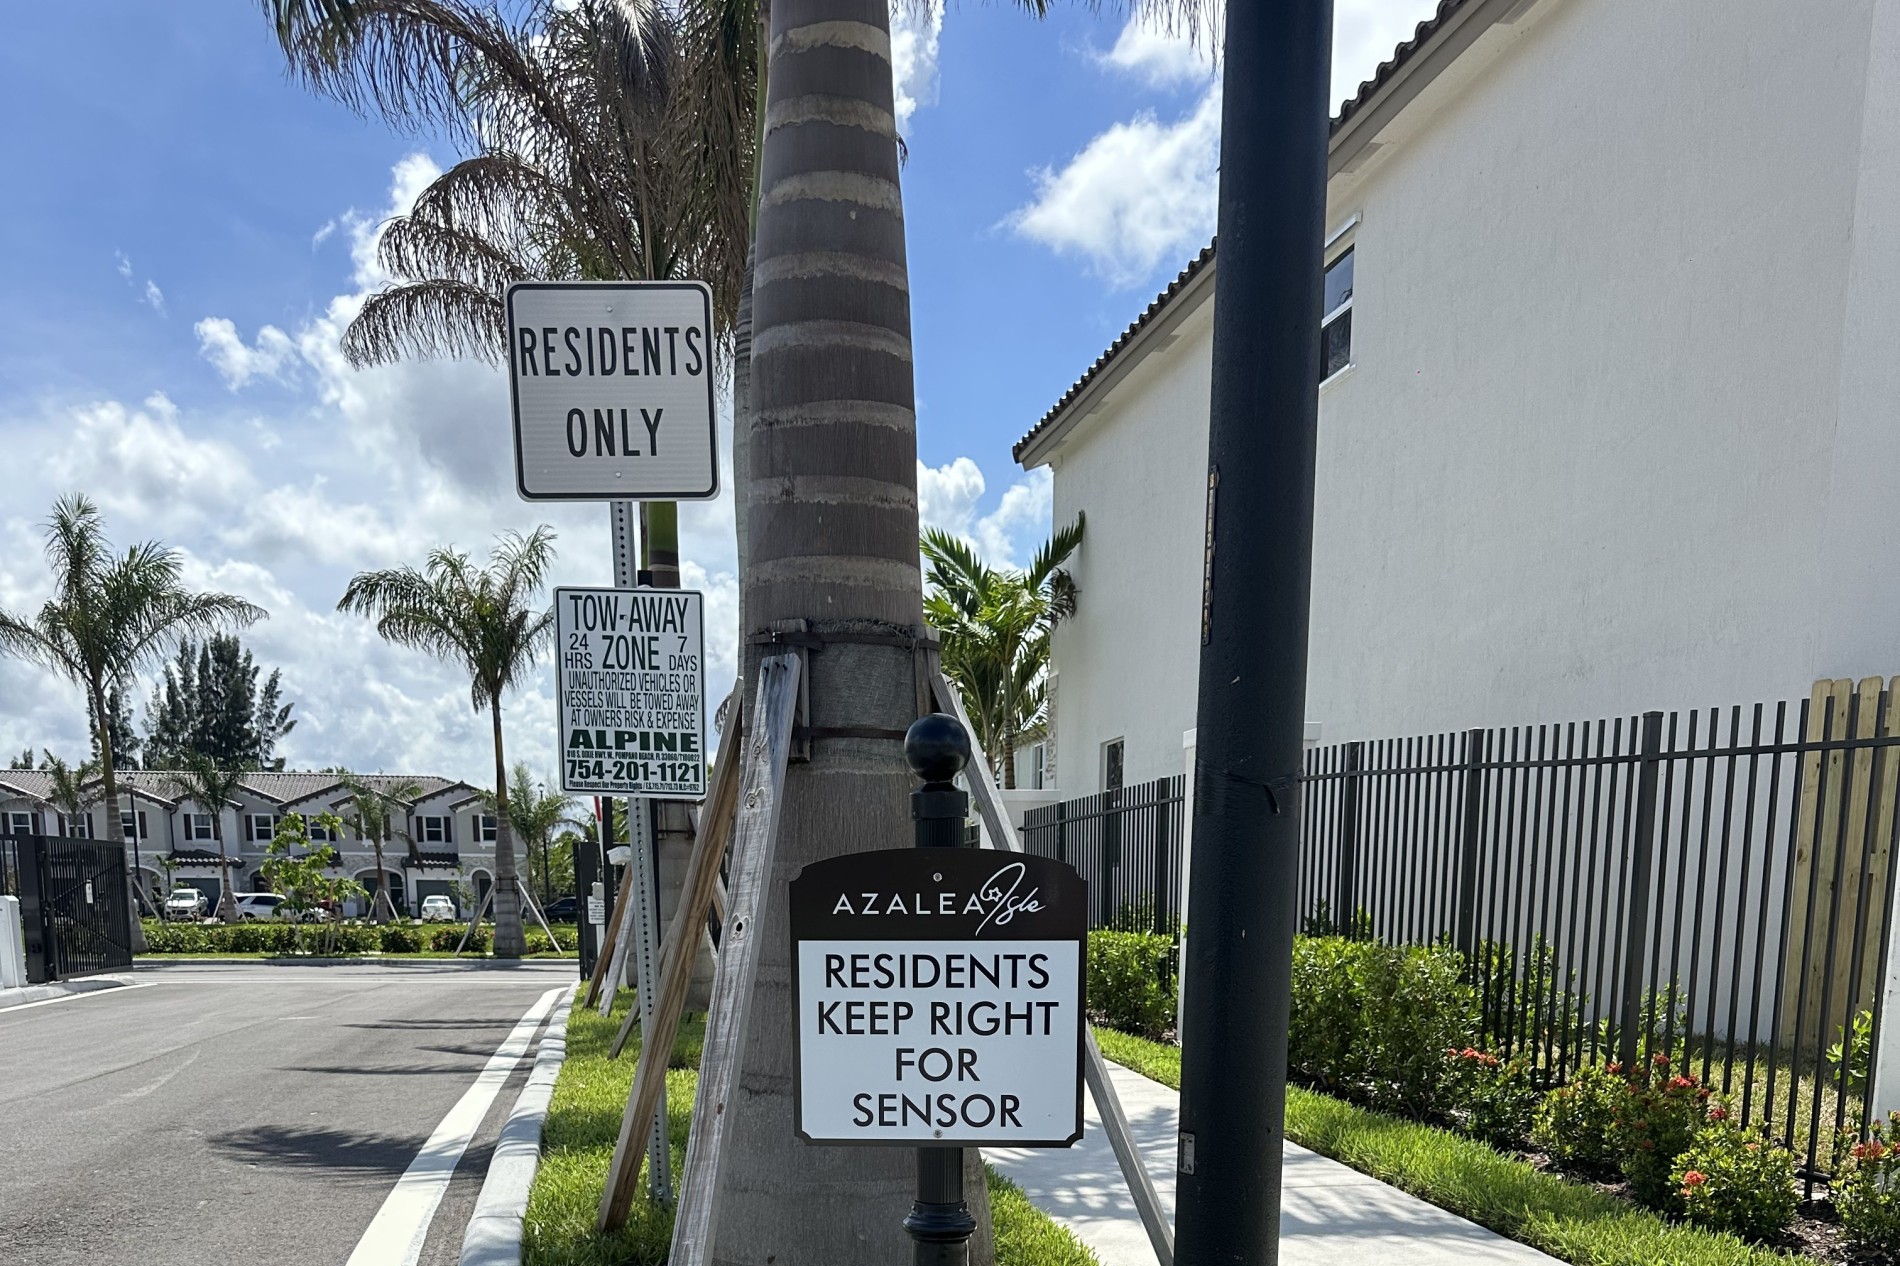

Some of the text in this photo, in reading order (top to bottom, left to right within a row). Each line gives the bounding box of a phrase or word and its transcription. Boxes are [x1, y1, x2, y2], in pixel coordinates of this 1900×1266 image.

[519, 326, 703, 377] RESIDENTS
[566, 408, 664, 457] ONLY
[569, 594, 689, 634] TOW-AWAY
[569, 633, 589, 651] 24
[601, 634, 661, 671] ZONE
[677, 636, 688, 653] 7
[564, 652, 593, 670] HRS
[669, 654, 698, 672] DAYS
[568, 670, 696, 693] UNAUTHORIZED VEHICLES OR
[564, 690, 699, 711] VESSELS WILL BE TOWED AWAY
[570, 709, 696, 730] AT OWNERS RISK & EXPENSE
[568, 729, 699, 752] ALPINE
[566, 759, 700, 782] 754-201-1121
[832, 862, 1047, 936] AZALEA Isle
[825, 953, 1050, 989] RESIDENTS
[817, 1001, 1060, 1036] KEEP RIGHT
[895, 1047, 981, 1082] FOR
[852, 1093, 1023, 1128] SENSOR
